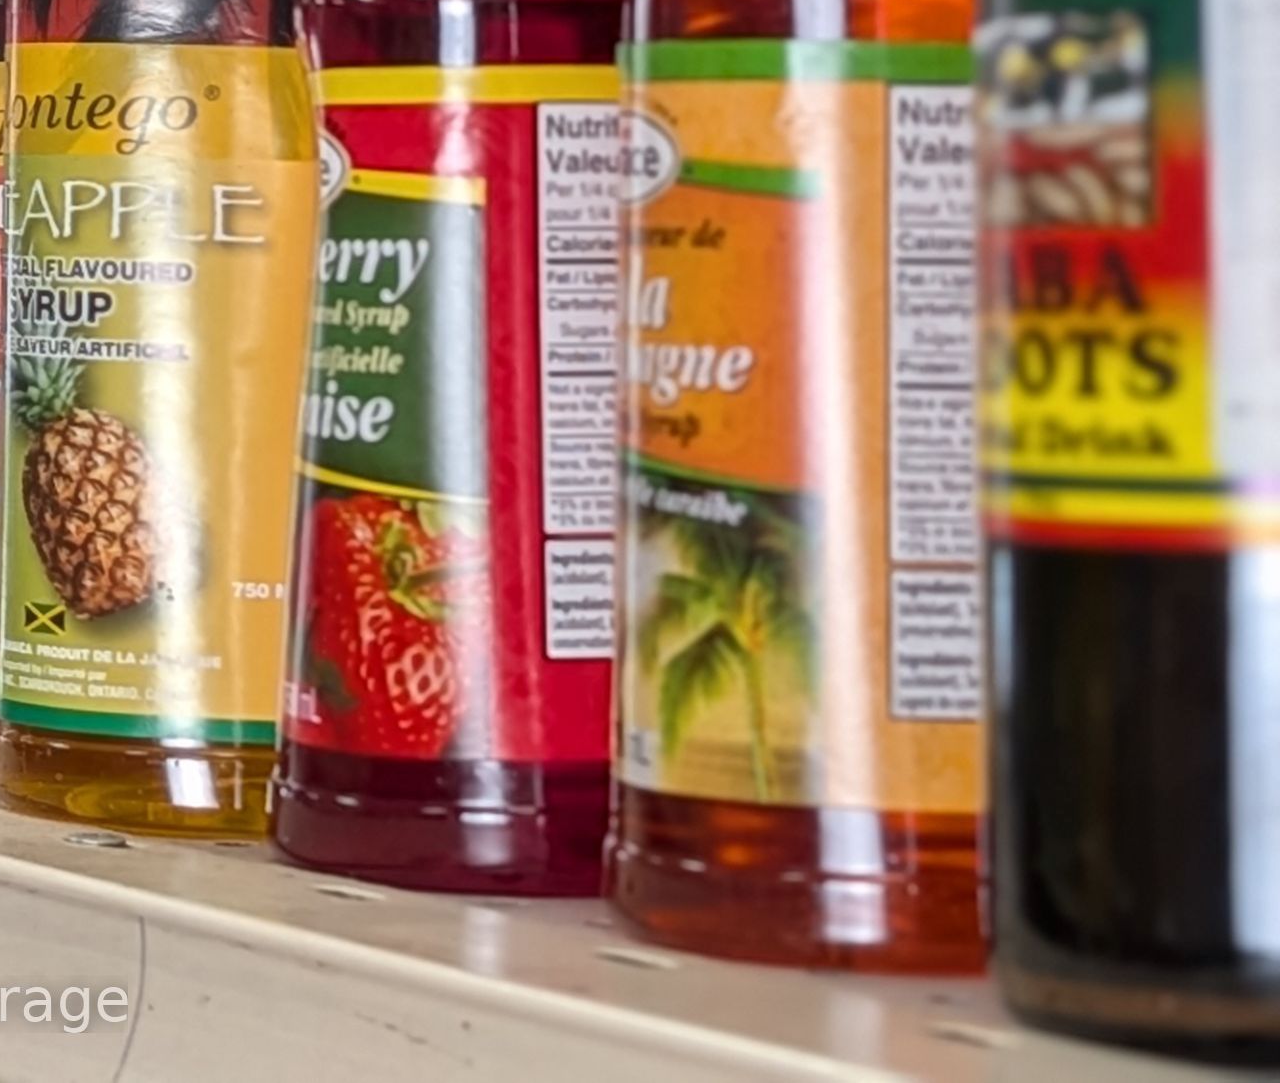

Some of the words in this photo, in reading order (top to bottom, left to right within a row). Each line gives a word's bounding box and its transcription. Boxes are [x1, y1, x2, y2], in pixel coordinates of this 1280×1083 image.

[45, 258, 193, 282] FLAVOURED
[345, 300, 411, 335] Syrup
[232, 581, 270, 599] 750
[36, 645, 90, 661] PRODUIT
[92, 649, 113, 663] DE
[116, 651, 136, 665] LA
